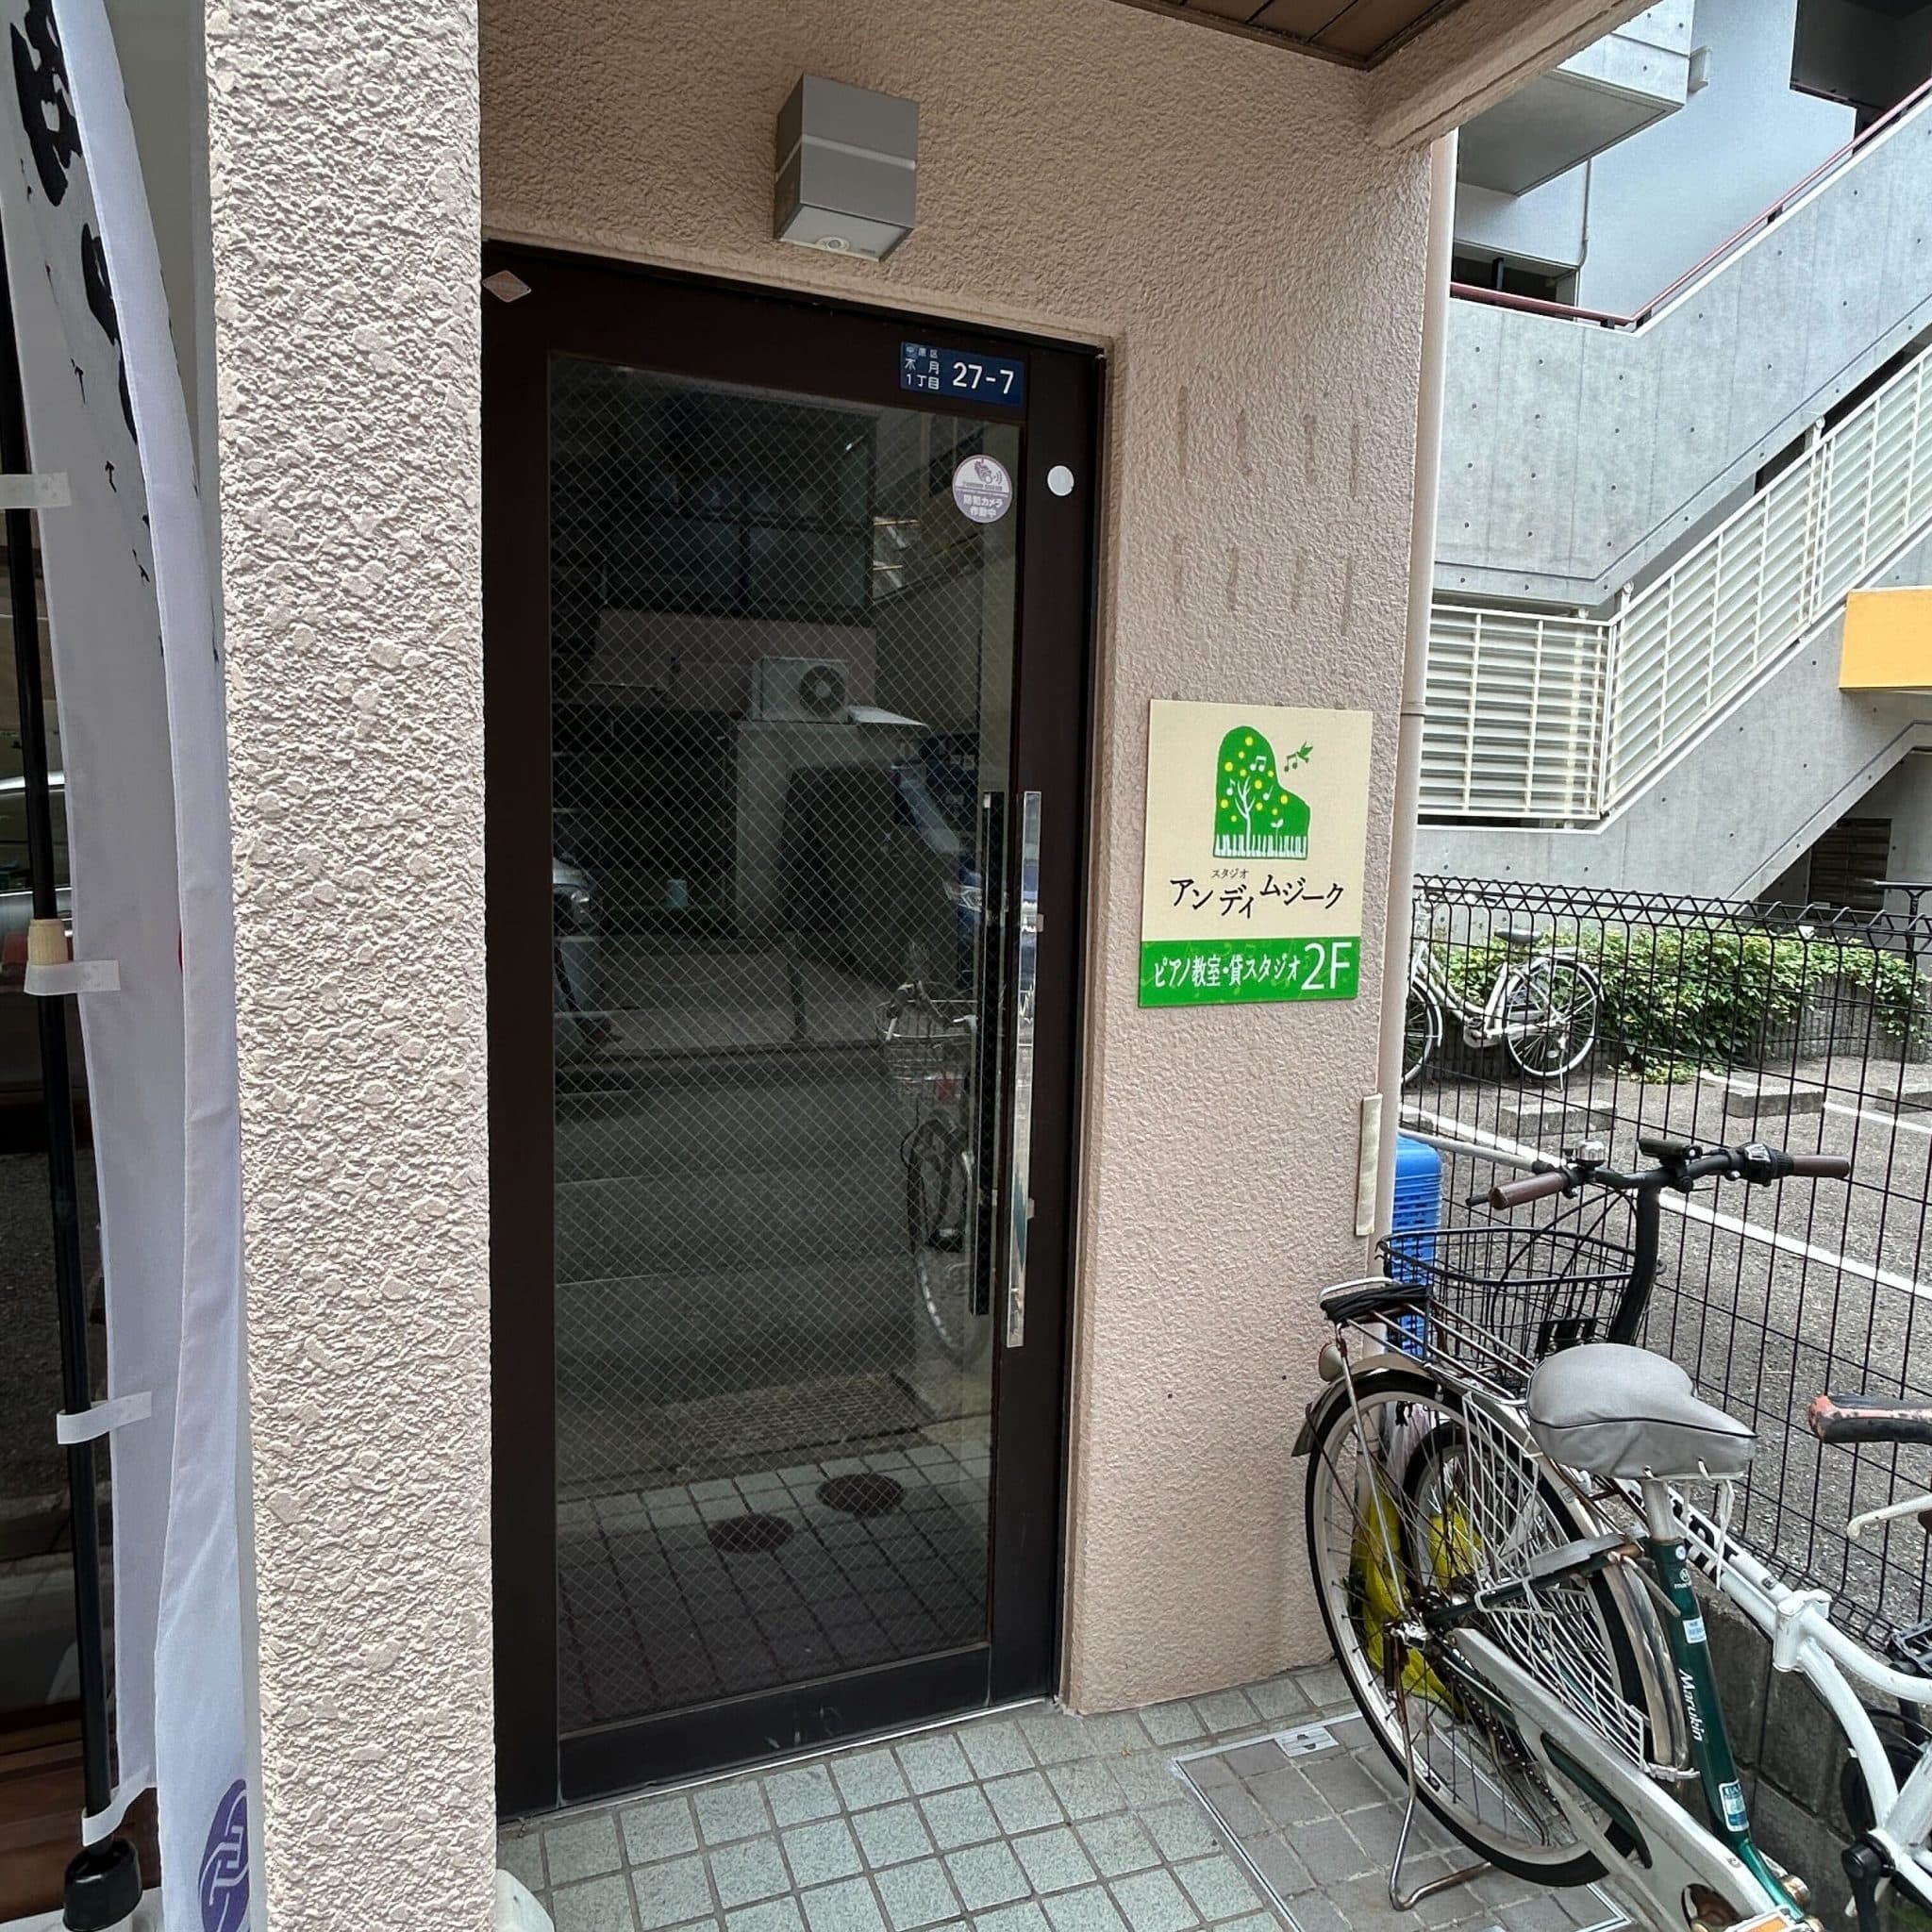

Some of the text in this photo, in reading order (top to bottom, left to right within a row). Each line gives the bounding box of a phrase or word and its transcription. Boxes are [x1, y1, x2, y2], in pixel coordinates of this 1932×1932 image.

[907, 374, 940, 391] 1丁目
[953, 361, 1015, 395] 27-7
[1211, 868, 1250, 880] スタジオ
[1301, 941, 1353, 991] 2F
[1678, 1667, 1706, 1742] Marukin
